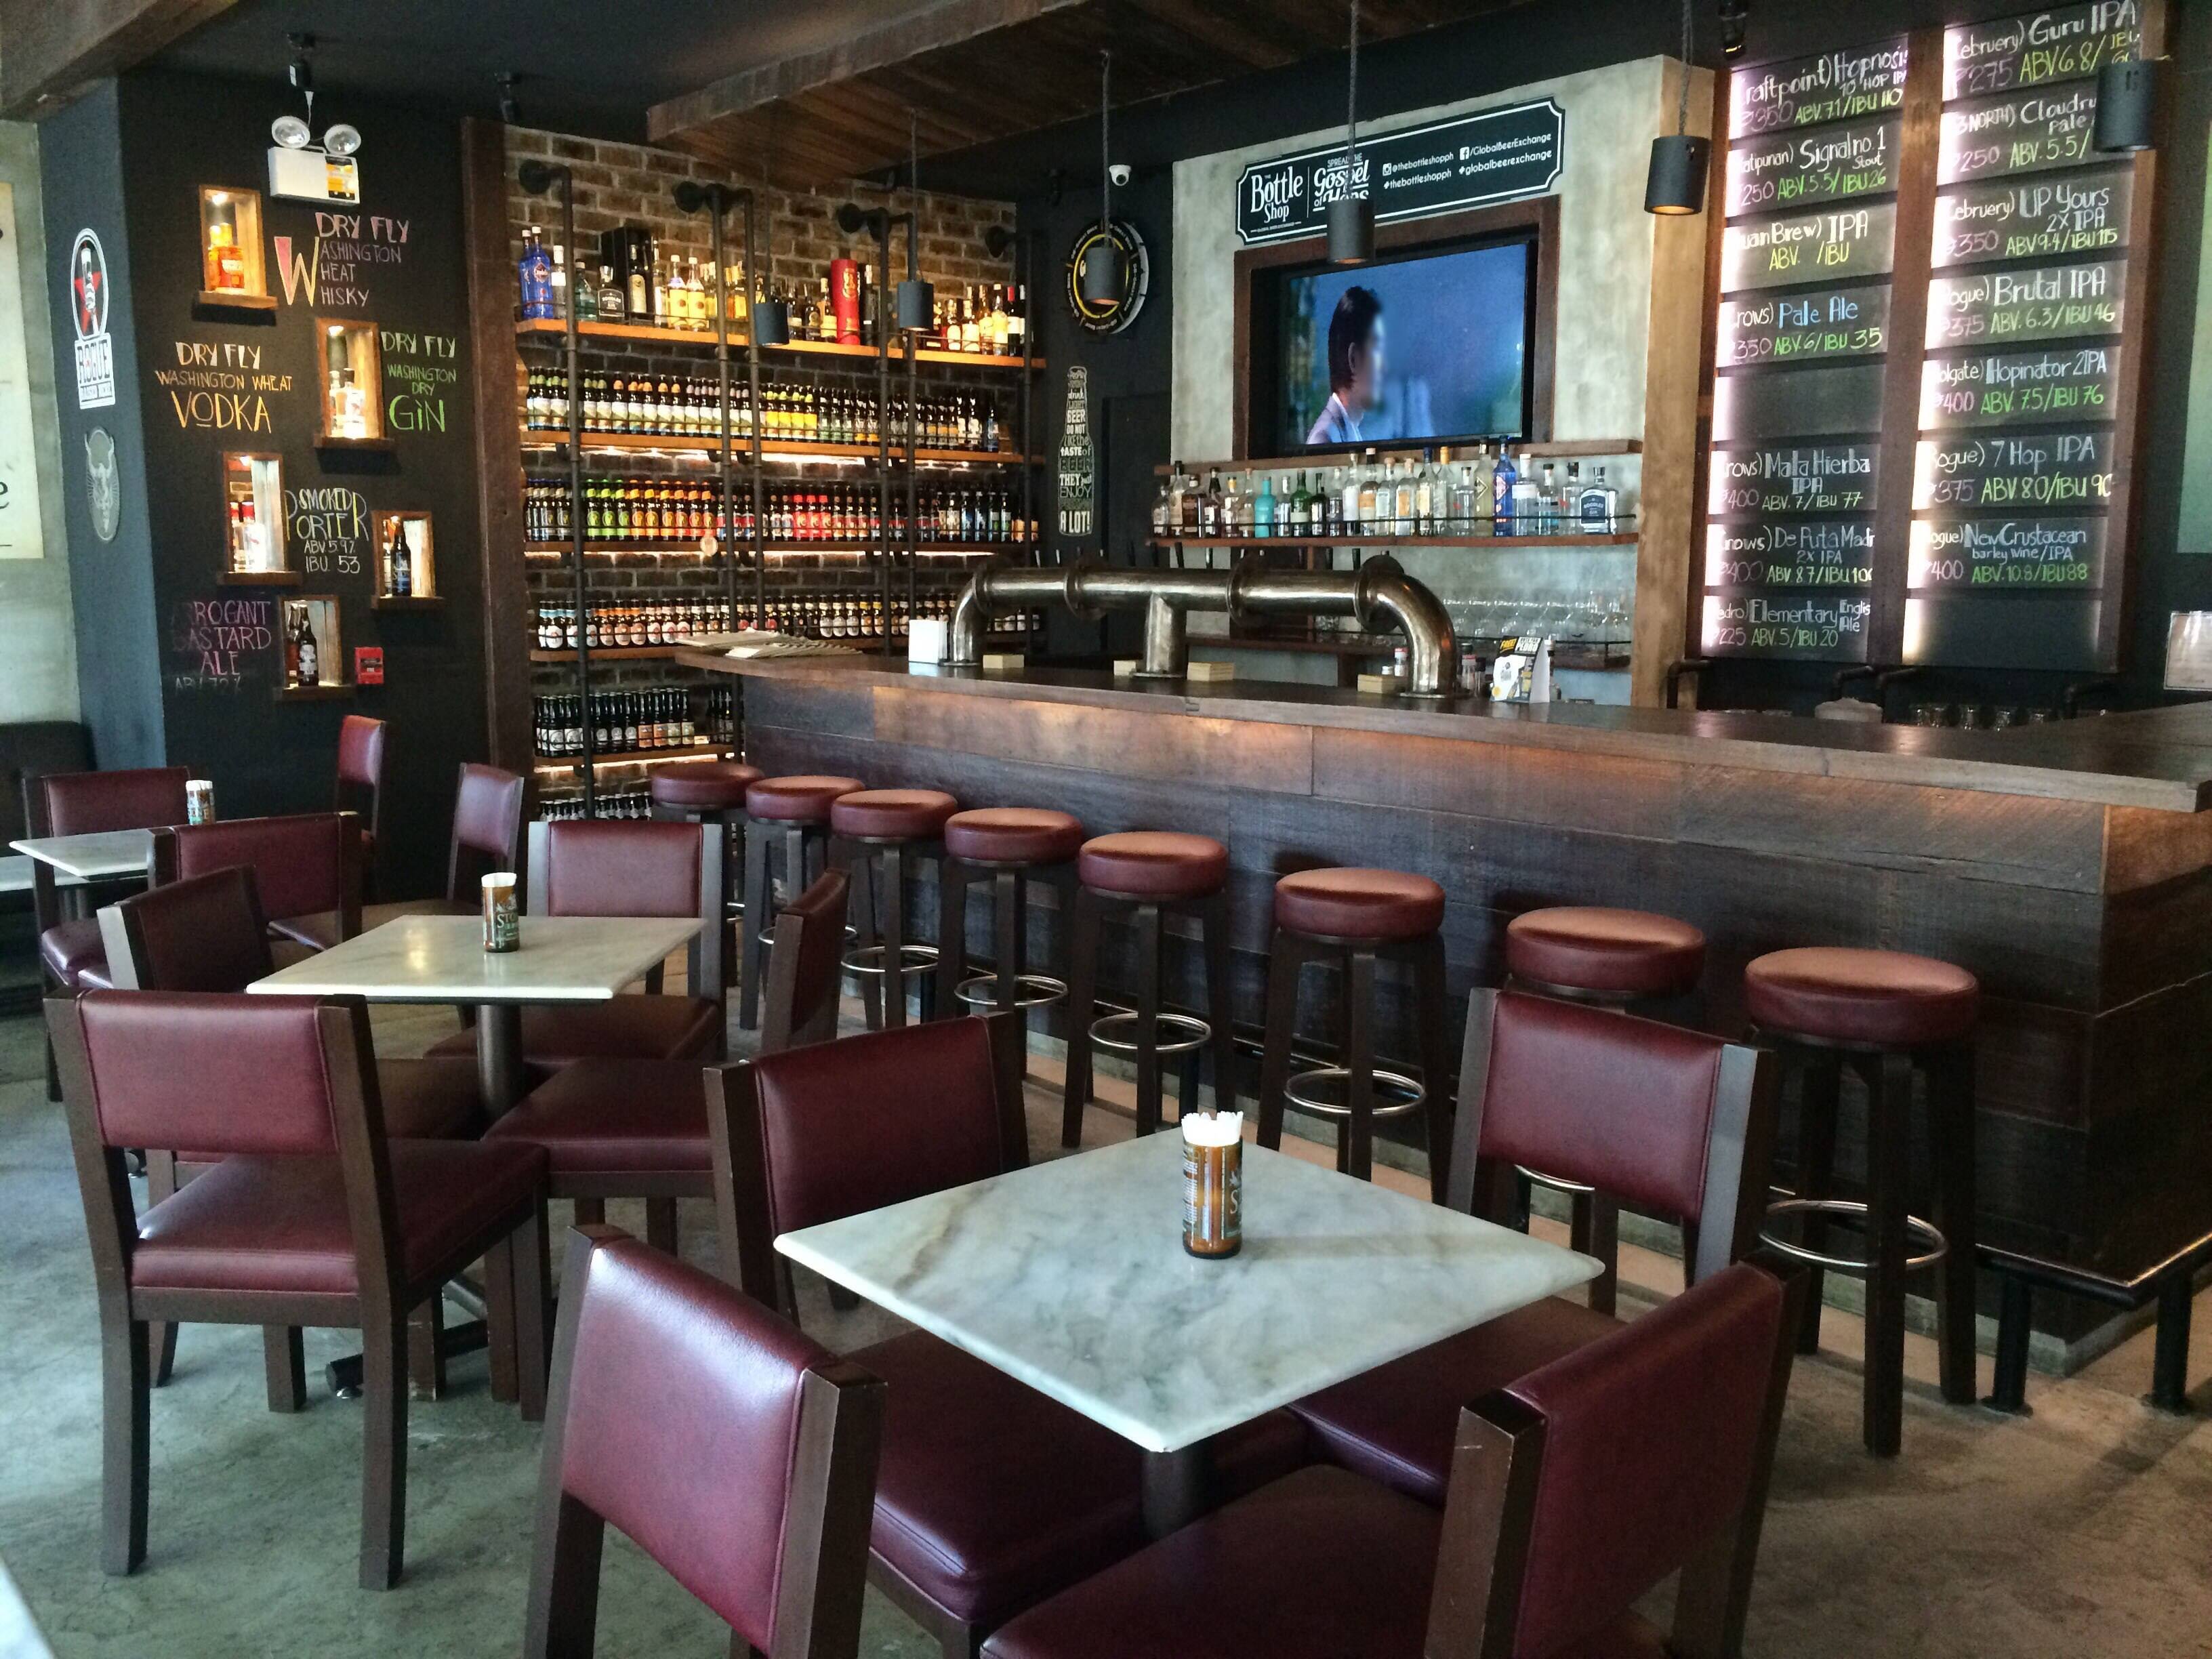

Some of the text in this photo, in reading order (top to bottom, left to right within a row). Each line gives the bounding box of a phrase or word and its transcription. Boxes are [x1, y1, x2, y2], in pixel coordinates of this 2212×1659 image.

[2028, 14, 2085, 45] Guru
[2091, 0, 2135, 35] IPA
[1864, 73, 1889, 91] HOP
[1881, 88, 1903, 107] 110
[1354, 152, 1363, 163] HE
[1741, 142, 1793, 176] atipunan)
[1800, 132, 1851, 172] Signal
[1877, 126, 1886, 150] 1
[1953, 146, 1999, 172] 250
[1458, 150, 1552, 176] #globalbeerexchange
[1250, 166, 1303, 213] Bottle
[1384, 169, 1452, 190] #thebottleshopph
[1740, 181, 1774, 206] 250
[2020, 187, 2051, 218] UP
[2056, 184, 2110, 213] Yours
[1264, 203, 1290, 223] Shop
[2075, 207, 2105, 231] IPA
[316, 212, 409, 243] DRY FLY
[1827, 211, 1868, 243] IPA
[1994, 270, 2061, 306] Brutal
[2069, 266, 2106, 299] IPA
[1735, 296, 1858, 329] rows) Pale Ale
[2094, 303, 2115, 322] 46
[381, 331, 456, 358] DRY FLY
[1850, 327, 1883, 348] 35
[77, 339, 110, 384] ROGUE
[176, 342, 261, 369] DRY FLY
[154, 370, 293, 392] WASHINGTON WHEAT
[387, 365, 457, 382] WASHINGTON
[1938, 360, 1984, 387] olgate)
[1986, 354, 2072, 388] Hopinator
[411, 382, 435, 396] DRY
[2083, 384, 2104, 405] 76
[171, 390, 272, 434] VODKA
[1723, 448, 1870, 478] rows) Mala Hierba
[1991, 441, 2005, 467] 7
[2010, 441, 2047, 474] Hop
[2057, 436, 2095, 462] IPA
[1059, 473, 1081, 486] THEY
[1791, 477, 1823, 495] IPA
[299, 488, 352, 510] SMOKED
[1060, 486, 1091, 498] ENJOY
[1841, 491, 1863, 508] 77
[1069, 510, 1090, 533] LOT!
[1723, 525, 1771, 552] rows)
[1775, 527, 1797, 548] De
[1801, 525, 1838, 548] Puta
[1930, 525, 1963, 550] ogue)
[2000, 523, 2087, 546] Crustacean
[337, 556, 361, 574] 53
[1820, 550, 1843, 564] IPA
[1972, 546, 2007, 565] barley
[2067, 562, 2088, 580] 88
[1718, 599, 1749, 620] edro)
[1749, 599, 1838, 628] Elementary
[1839, 616, 1860, 632] Ale
[1821, 630, 1838, 647] 20
[201, 651, 241, 675] ALE
